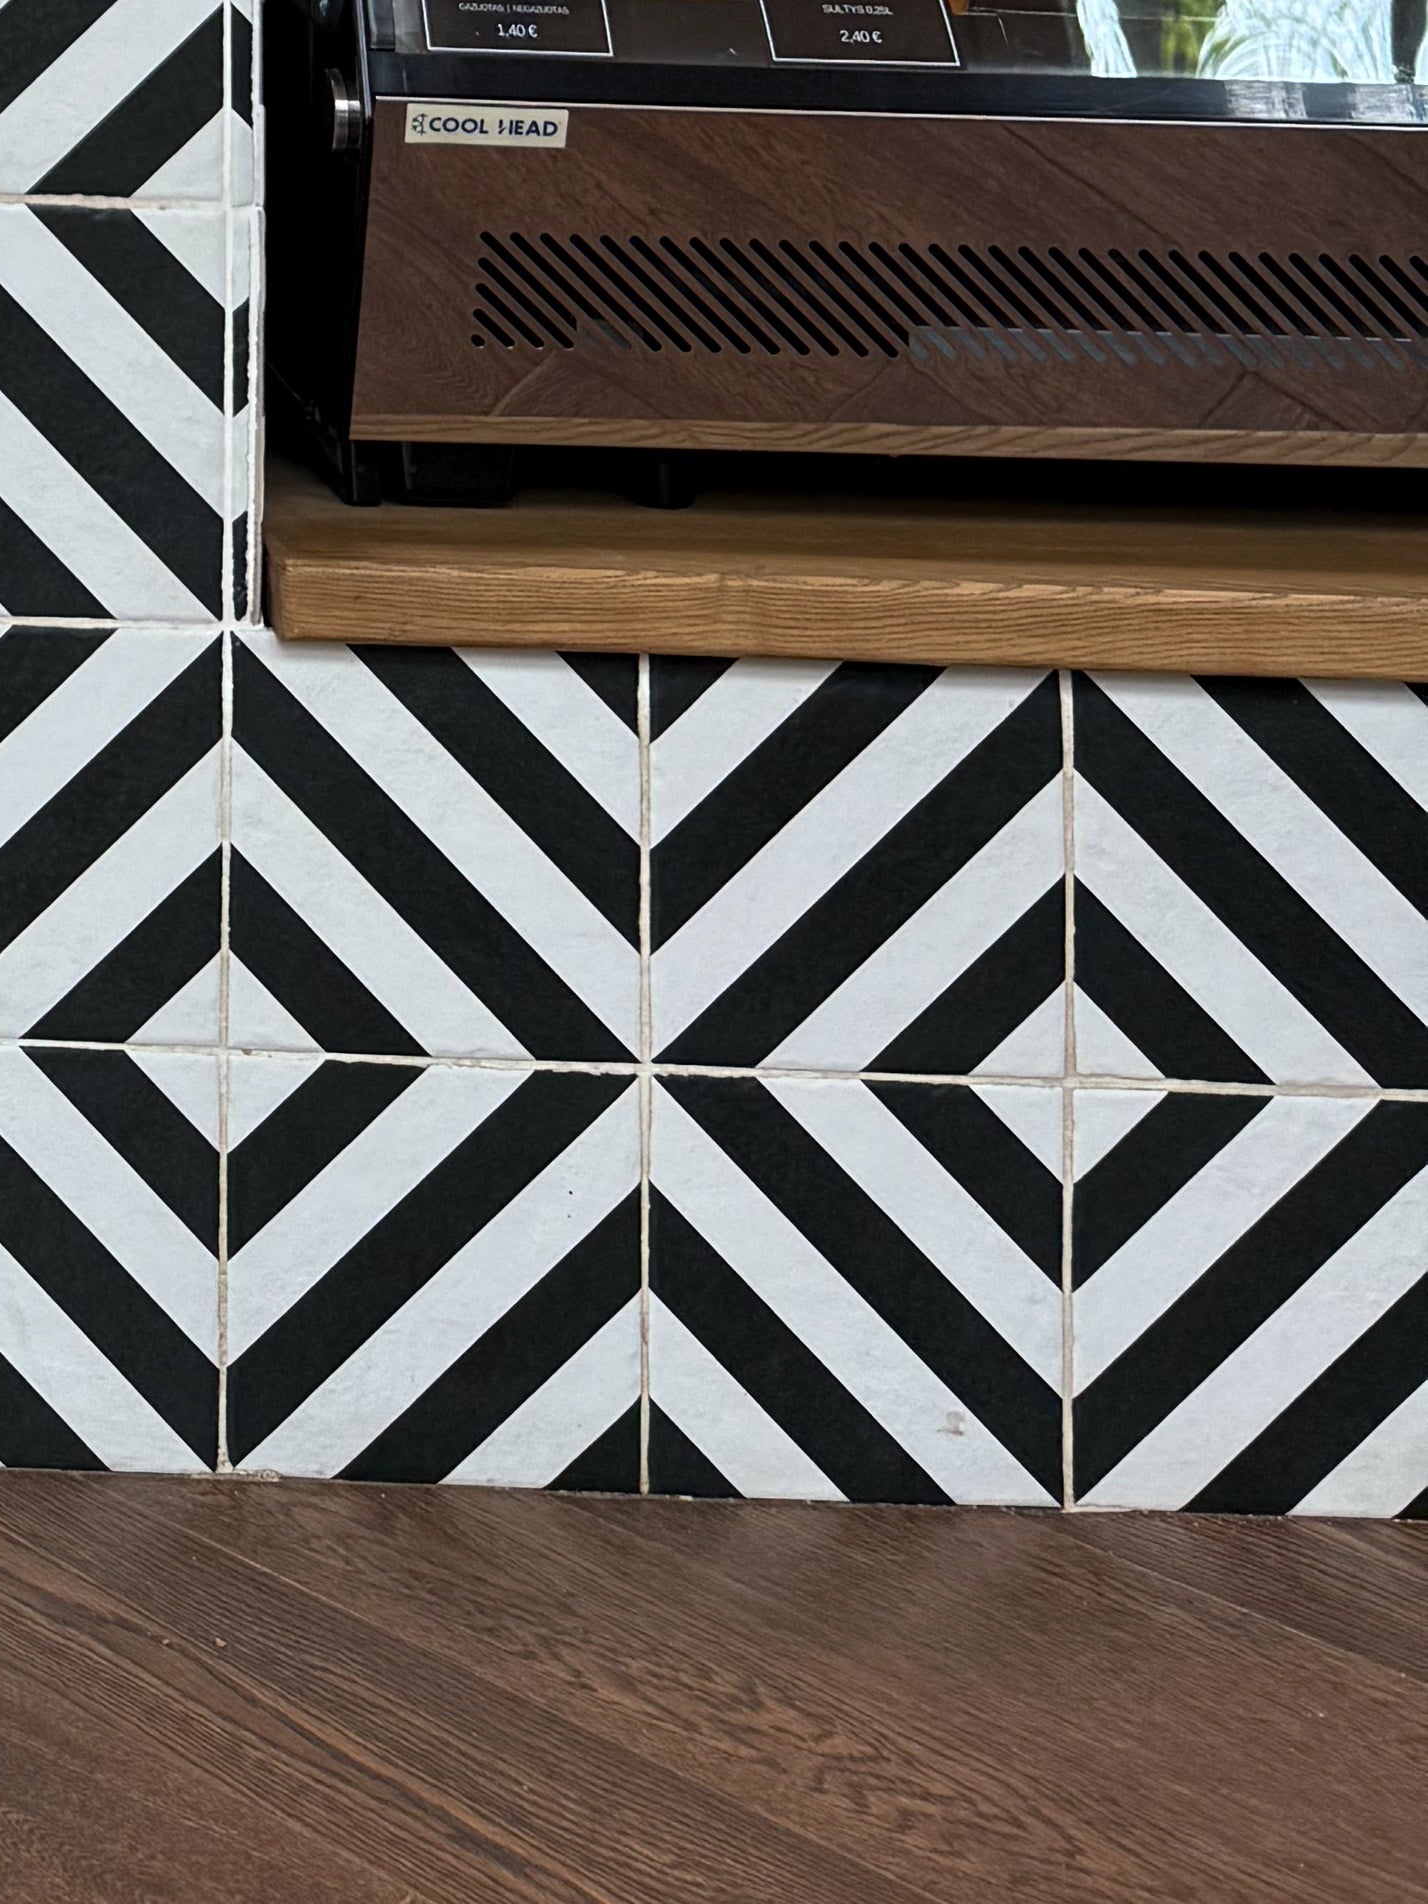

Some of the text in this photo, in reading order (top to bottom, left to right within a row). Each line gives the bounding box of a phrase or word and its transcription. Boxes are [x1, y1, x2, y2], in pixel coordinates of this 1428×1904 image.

[528, 24, 538, 38] €
[872, 31, 883, 43] €
[429, 117, 489, 134] COOL
